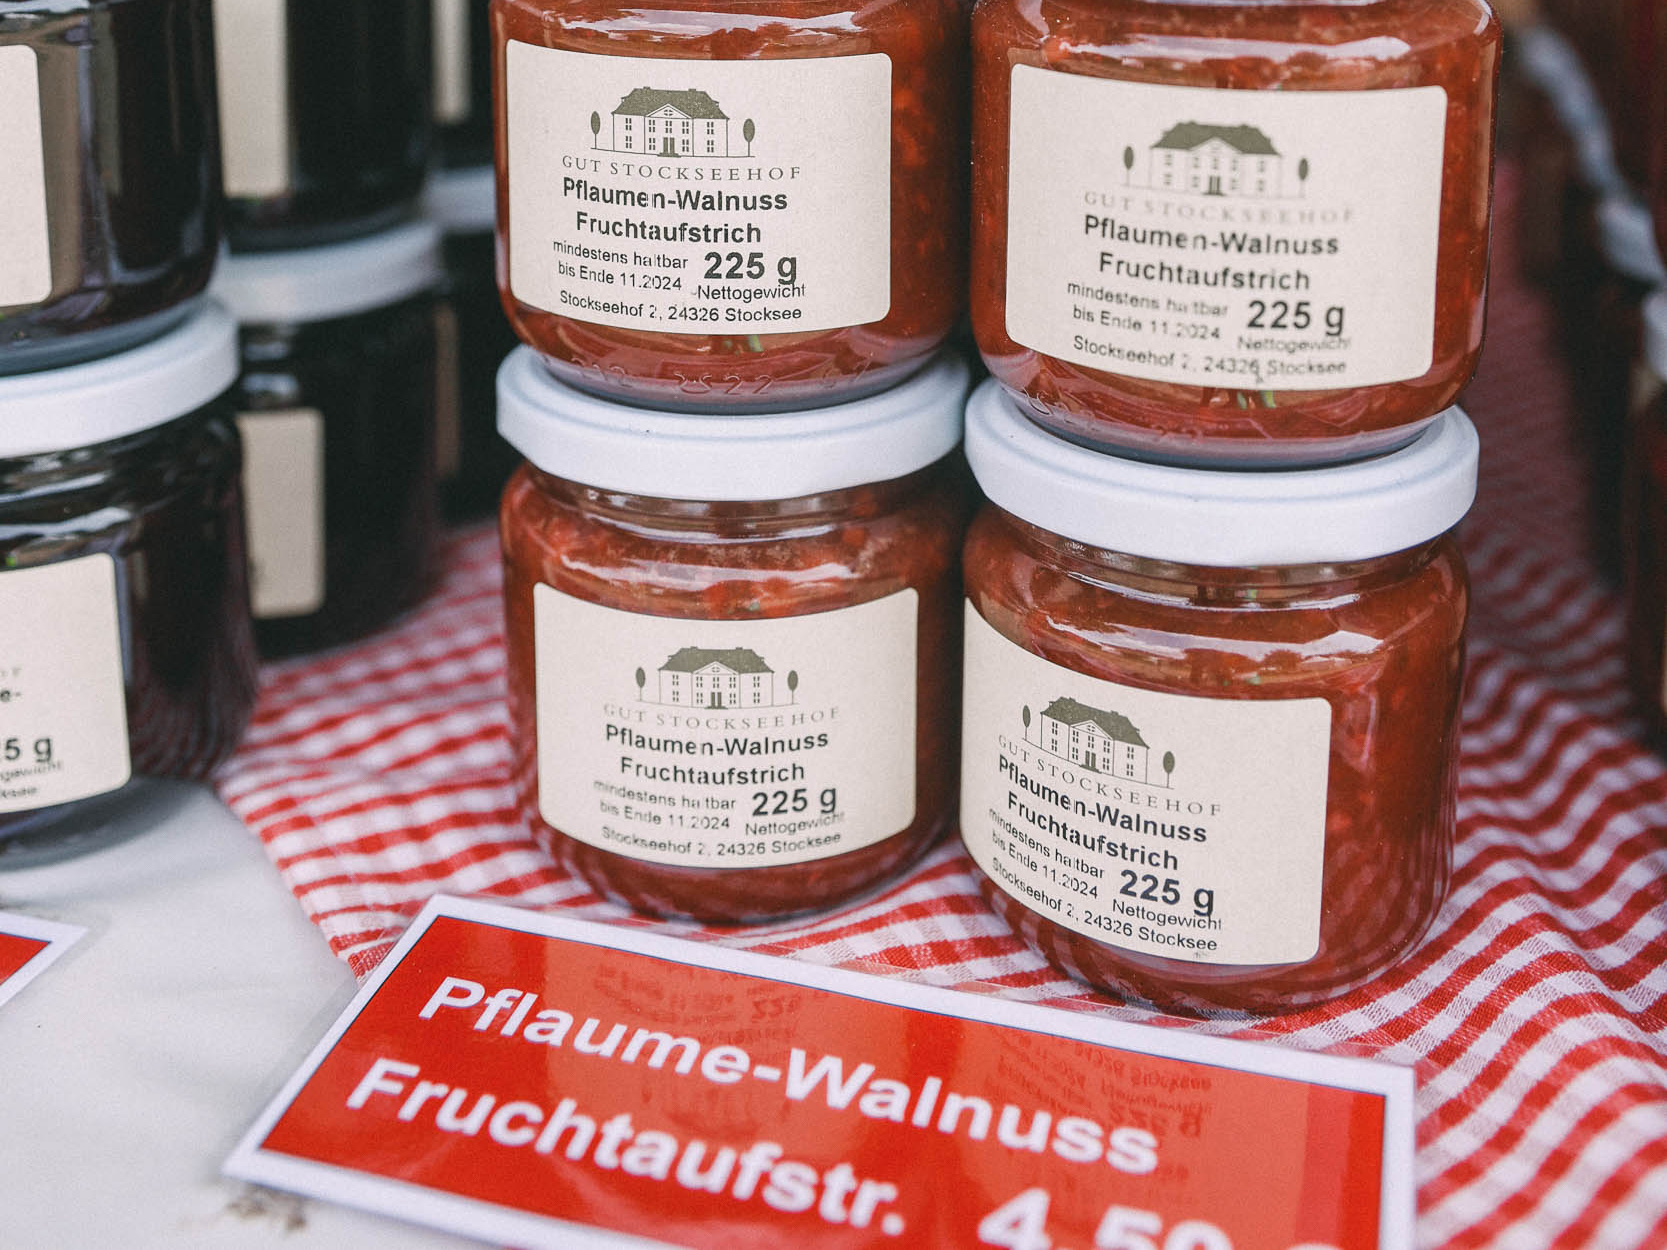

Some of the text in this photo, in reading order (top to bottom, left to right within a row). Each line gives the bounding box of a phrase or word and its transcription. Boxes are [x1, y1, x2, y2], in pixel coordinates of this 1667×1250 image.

[562, 155, 801, 181] GUT STOCKSEEHOF
[563, 176, 788, 211] Pflaumen-Walnuss
[1084, 191, 1131, 211] GUT
[576, 211, 761, 243] Fruchtaufstrich
[1084, 214, 1339, 255] Pflaumen-Walnuss
[553, 240, 628, 265] mindestens
[703, 251, 797, 285] 225 g
[558, 260, 576, 277] bis
[579, 265, 615, 284] Ende
[1099, 251, 1310, 290] Fruchtaufstrich
[560, 290, 644, 317] Stockseehof
[668, 306, 719, 321] 24326
[724, 306, 802, 322] Stocksee
[697, 283, 806, 303] Nettogewicht
[1067, 281, 1228, 317] mindestens hatbar
[1073, 304, 1094, 323] bis
[1100, 310, 1142, 330] Ende
[1247, 300, 1344, 337] 225 g
[1073, 335, 1175, 367] Stockseehof
[1204, 356, 1260, 374] 24326
[1267, 359, 1347, 376] Stocksee
[603, 703, 840, 730] GUT STOCKSEEHOF
[34, 737, 51, 763] g
[606, 723, 829, 756] Pflaumen-Walnuss
[621, 756, 805, 785] Fruchtaufstrich
[998, 734, 1221, 817] GUT STOCKSEEHOF
[593, 780, 736, 810] mindestens hatbar
[752, 787, 837, 817] 225 g
[999, 753, 1207, 843] Pflaumen-Walnuss
[600, 800, 620, 816] bis
[624, 805, 662, 825] Ende
[602, 825, 692, 854] Stockseehof
[717, 841, 766, 856] 24326
[771, 833, 841, 854] Stocksee
[989, 808, 1050, 858] mindestens
[1008, 790, 1178, 871] Fruchtaufstrich
[992, 828, 1006, 851] bis
[1008, 842, 1038, 872] Ende
[992, 857, 1062, 912] Stockseehof
[1084, 910, 1133, 937] 24326
[1138, 926, 1218, 951] Stocksee
[1119, 869, 1214, 917] 225 g
[1112, 898, 1222, 930] Nettogewicht
[418, 976, 1159, 1175] Pflaume-Walnuss
[346, 1057, 906, 1236] Fruchtaufstr.
